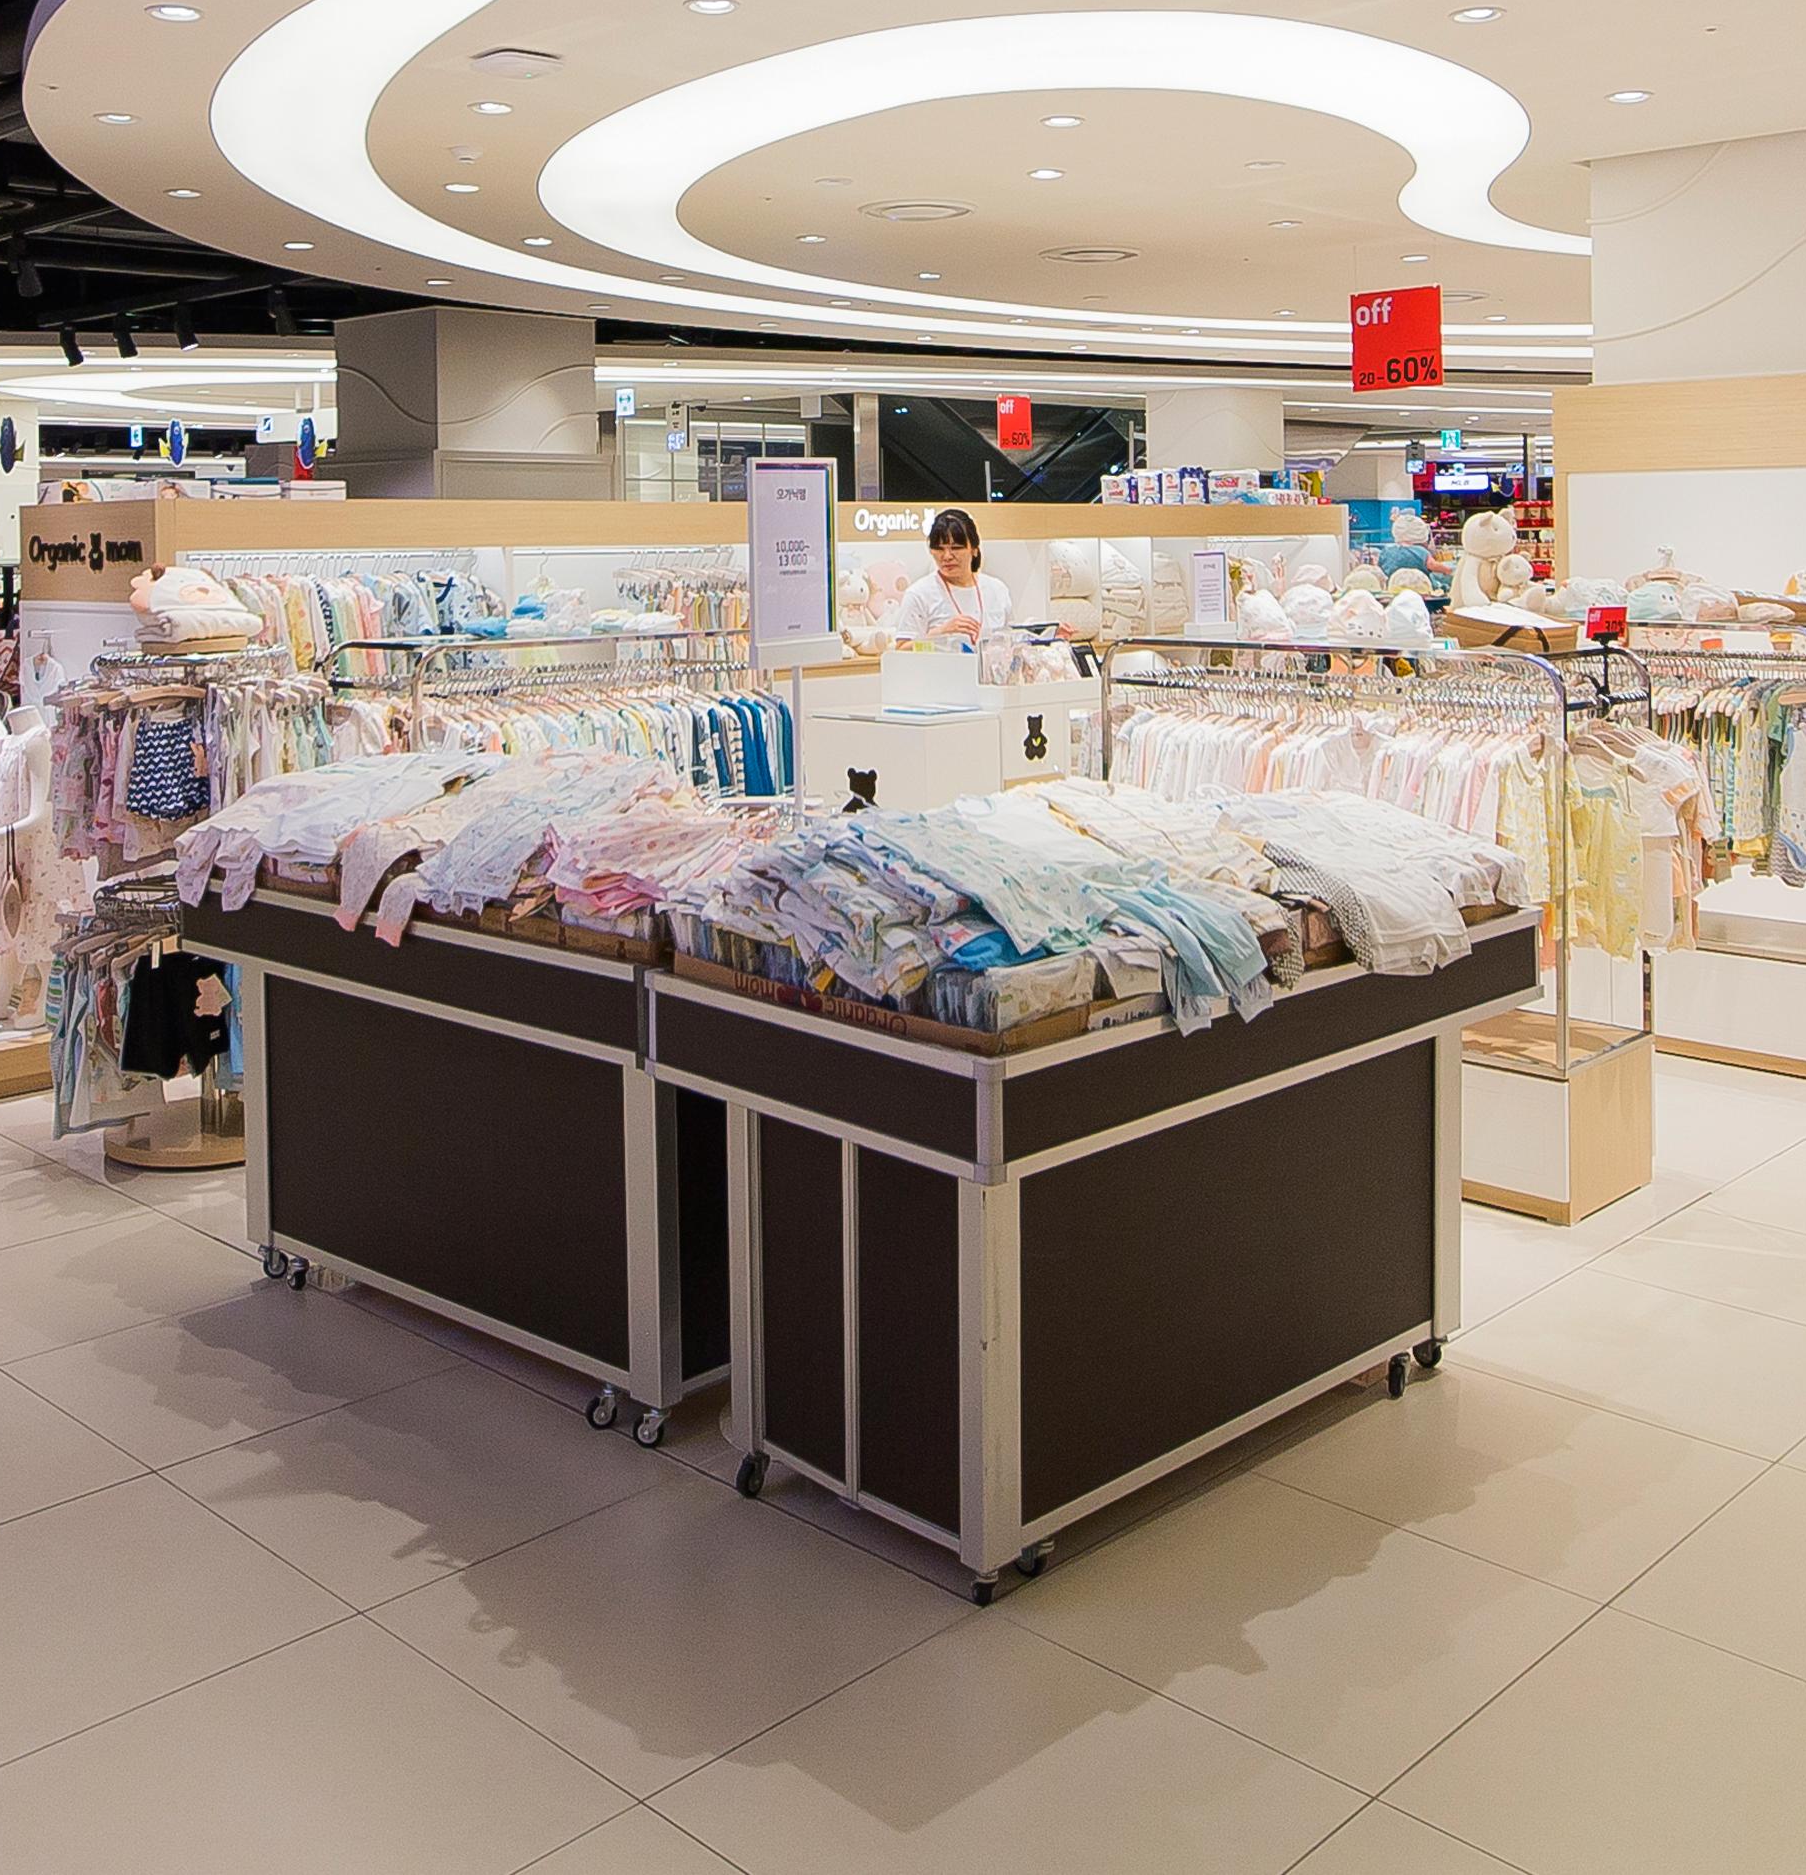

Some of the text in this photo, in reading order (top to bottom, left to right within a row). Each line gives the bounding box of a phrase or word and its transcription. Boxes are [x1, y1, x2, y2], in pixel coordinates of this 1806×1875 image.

[1356, 297, 1392, 326] off
[1000, 399, 1014, 414] off
[855, 508, 920, 537] Organic
[29, 534, 143, 571] Organic mom
[734, 972, 907, 1035] Organic mom
